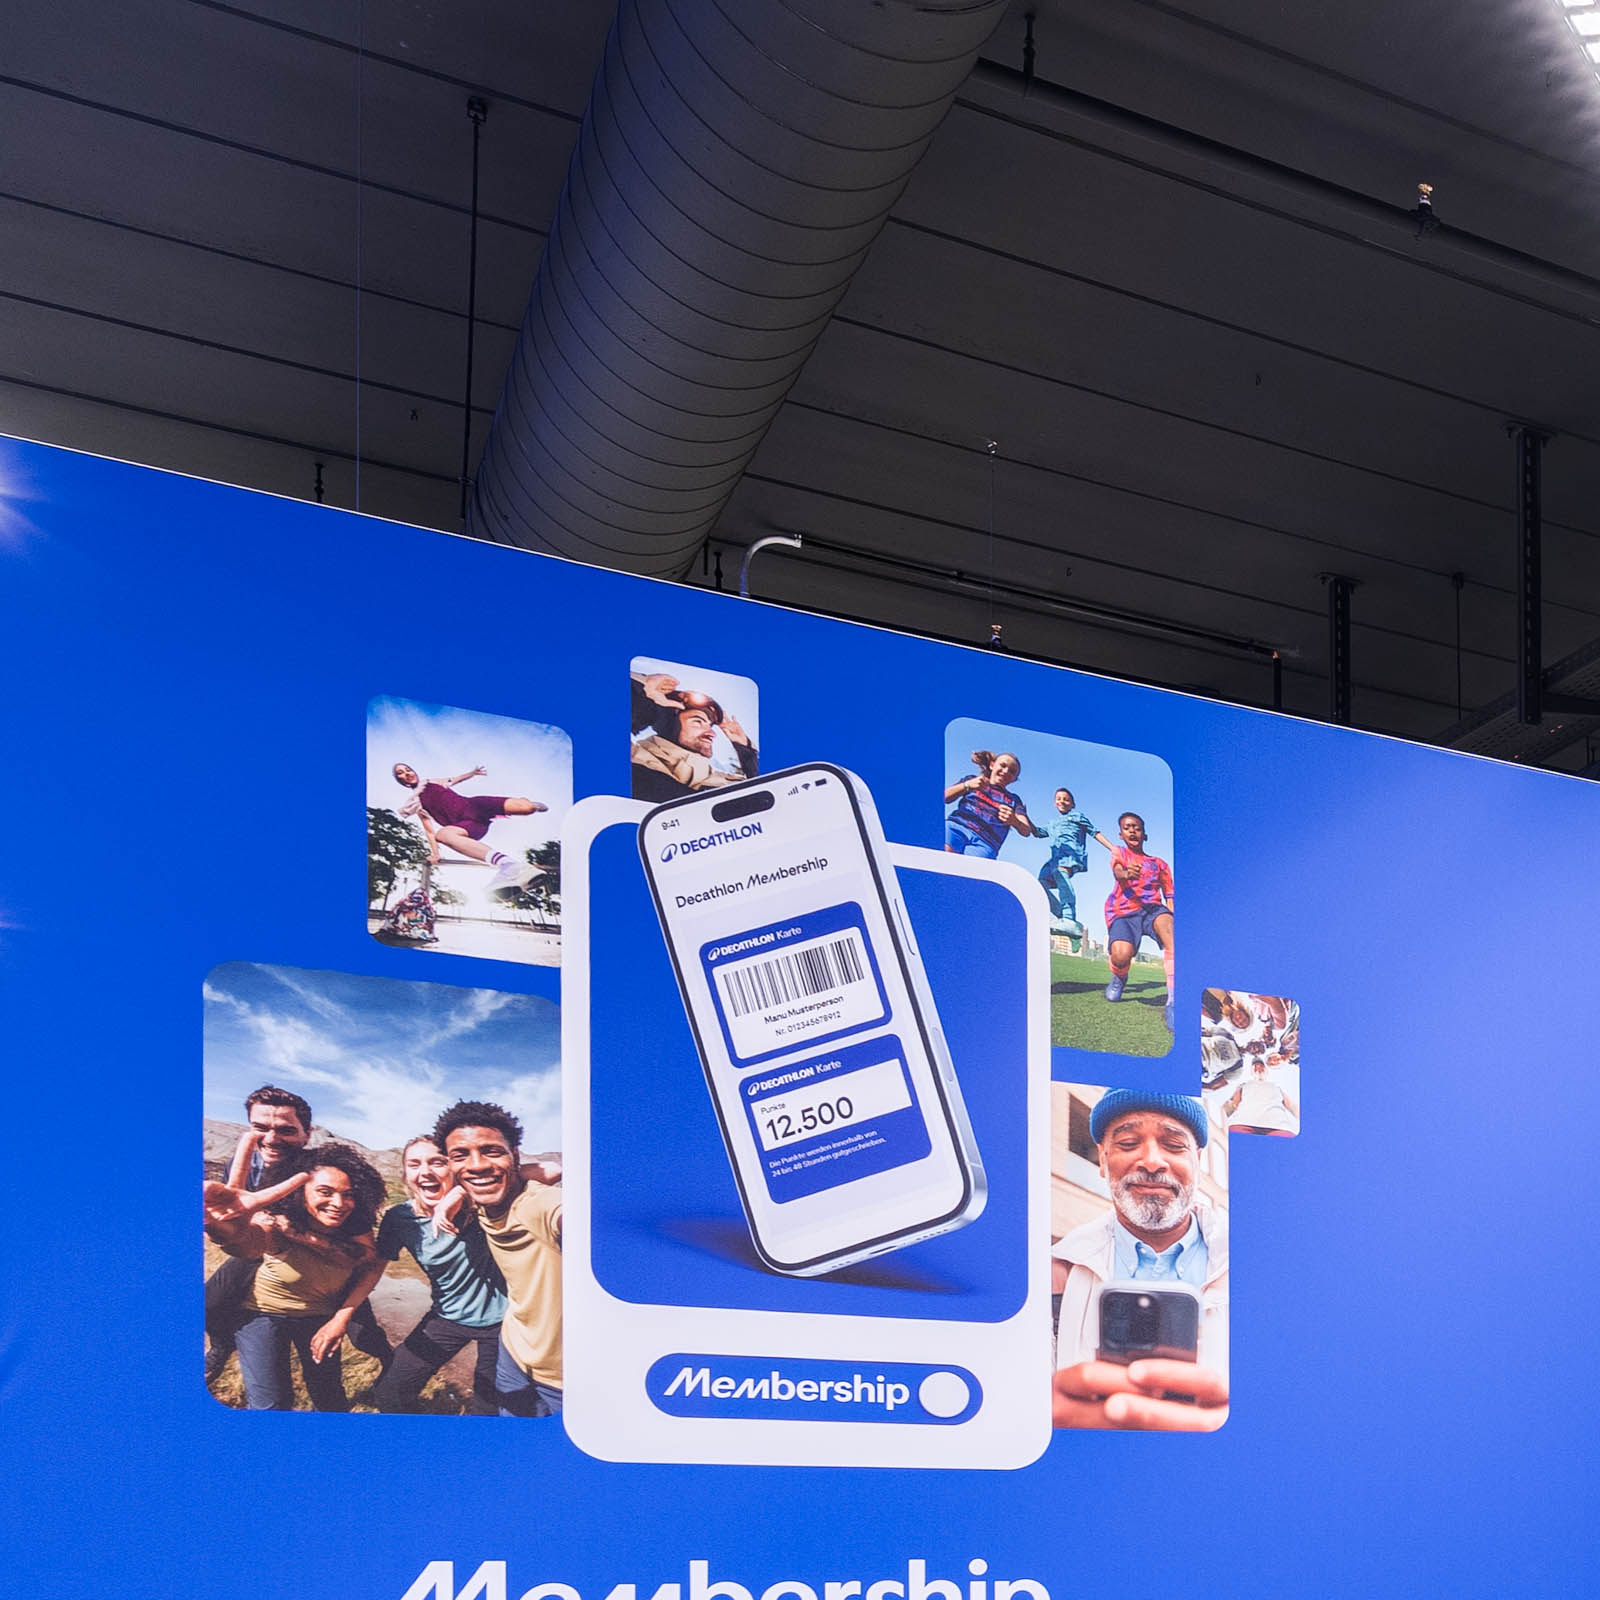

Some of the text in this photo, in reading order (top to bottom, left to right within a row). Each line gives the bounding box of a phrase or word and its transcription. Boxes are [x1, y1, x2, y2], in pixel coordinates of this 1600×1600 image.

[661, 818, 680, 830] 9:41
[680, 822, 763, 855] DECATHLON
[676, 857, 828, 908] Decathlon Membership
[720, 927, 801, 956] DECATHLON Karte
[764, 995, 844, 1024] Manu Musterperson
[760, 1061, 841, 1091] DECATHLON Karte
[761, 1103, 786, 1114] Punkte
[767, 1096, 853, 1141] 12.500
[769, 1130, 877, 1169] Die Punkte werden innerhalb von
[772, 1168, 781, 1177] 24
[783, 1164, 793, 1174] bis
[802, 1153, 832, 1168] Stunden
[663, 1367, 910, 1411] Membership
